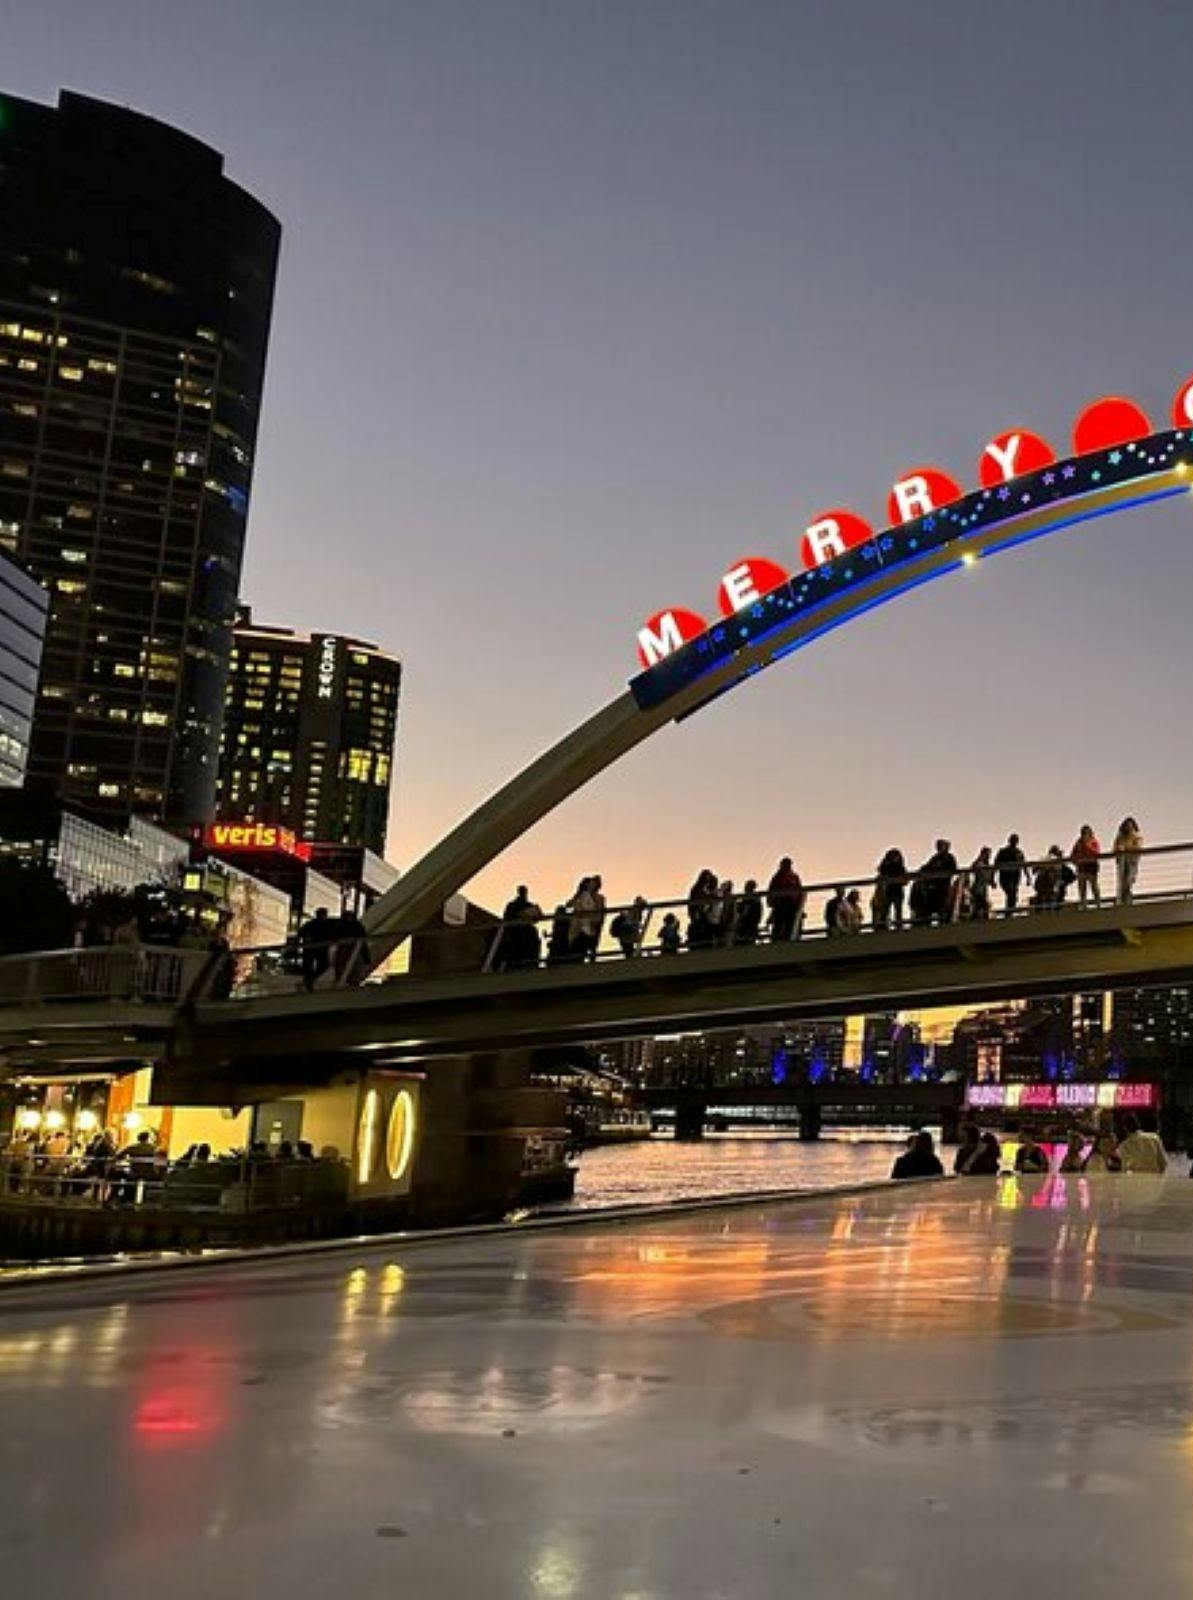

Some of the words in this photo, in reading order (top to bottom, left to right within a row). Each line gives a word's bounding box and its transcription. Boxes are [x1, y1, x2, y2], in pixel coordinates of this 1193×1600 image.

[637, 434, 1021, 668] MERRY
[318, 638, 337, 698] CROWN
[214, 823, 277, 847] veris
